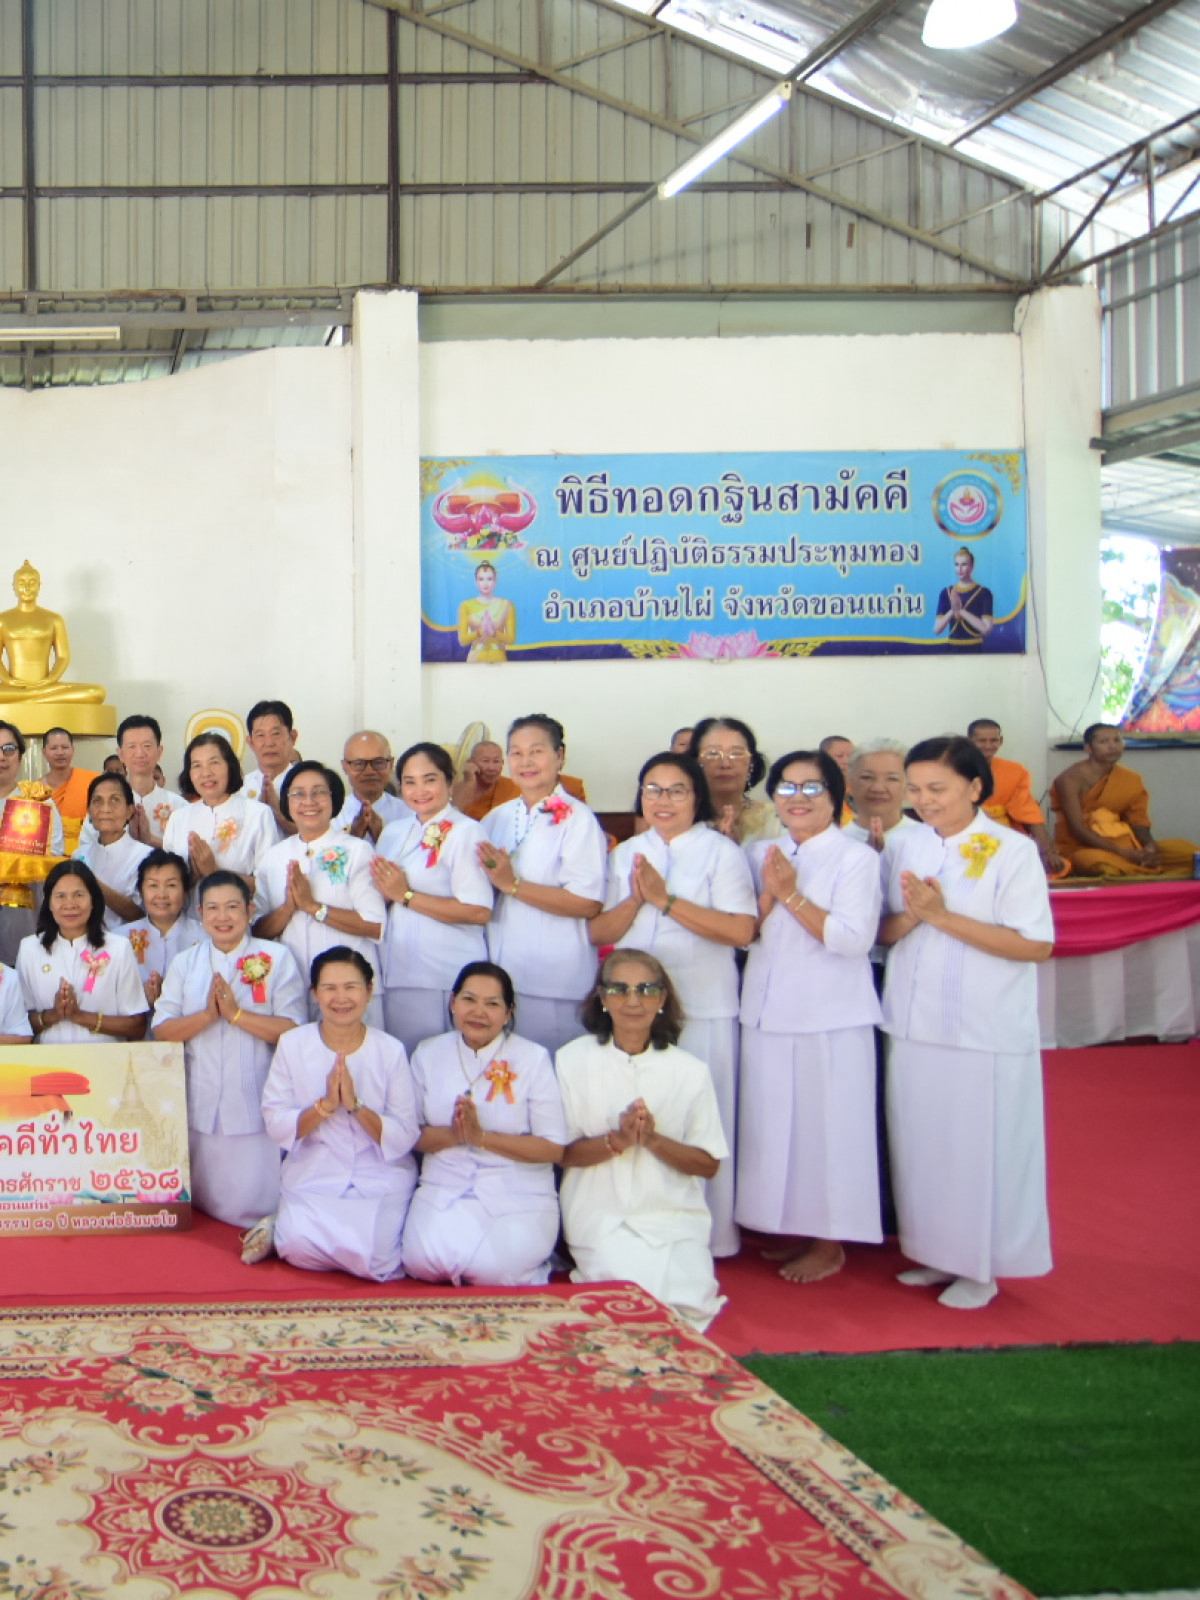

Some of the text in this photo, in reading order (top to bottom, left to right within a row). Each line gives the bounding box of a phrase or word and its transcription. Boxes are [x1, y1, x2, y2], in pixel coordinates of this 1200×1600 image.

[554, 467, 910, 526] พิธีทอดกฐินสามัคคี
[536, 535, 921, 577] ณ ศูนย์ปฏิบัติธรรมประทุมทอง
[544, 586, 924, 622] อำเภอบ้านไผ่ จังหวัดขอนแก่น
[90, 1168, 180, 1192] ๒๕๖๘
